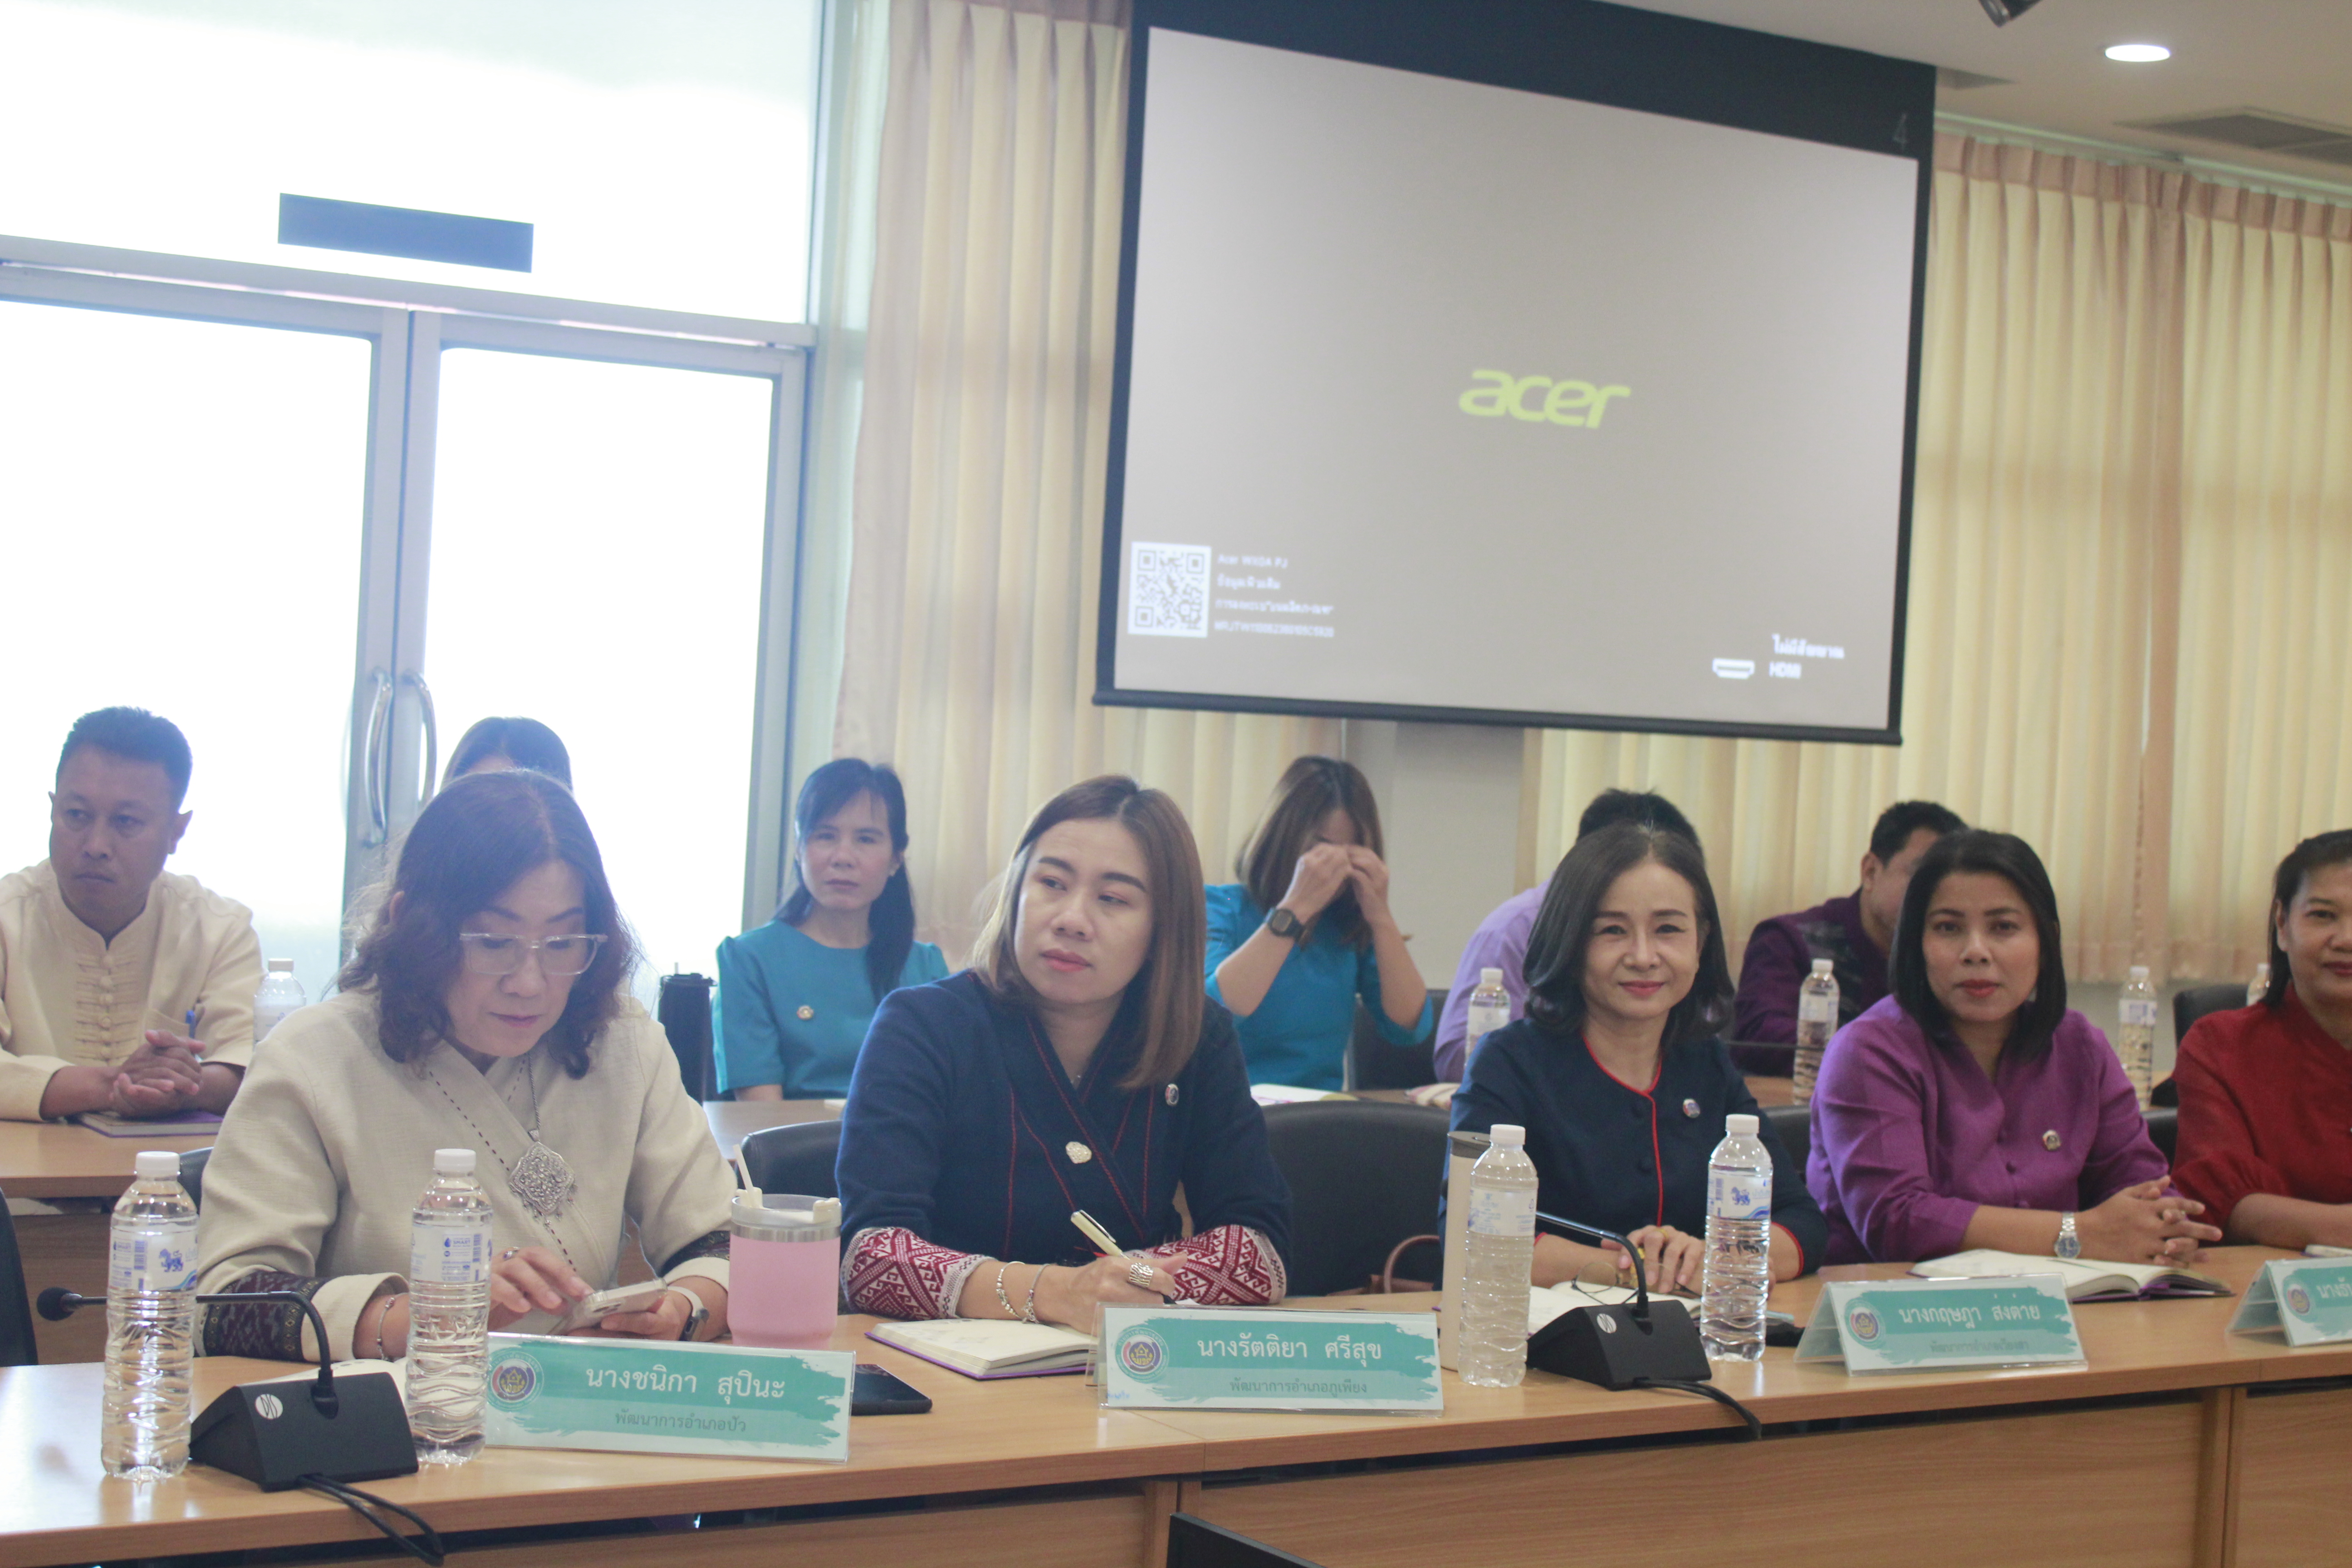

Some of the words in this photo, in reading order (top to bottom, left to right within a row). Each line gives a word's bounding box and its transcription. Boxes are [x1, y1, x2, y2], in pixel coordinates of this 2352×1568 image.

[1458, 368, 1632, 429] acer
[1197, 1332, 1308, 1358] นางรัตติยา
[1325, 1335, 1381, 1367] ศรีสุข
[586, 1364, 697, 1393] นางชนิกา
[718, 1369, 785, 1405] สุปินะ
[615, 1408, 746, 1432] พัฒนาการอำเภอปัว
